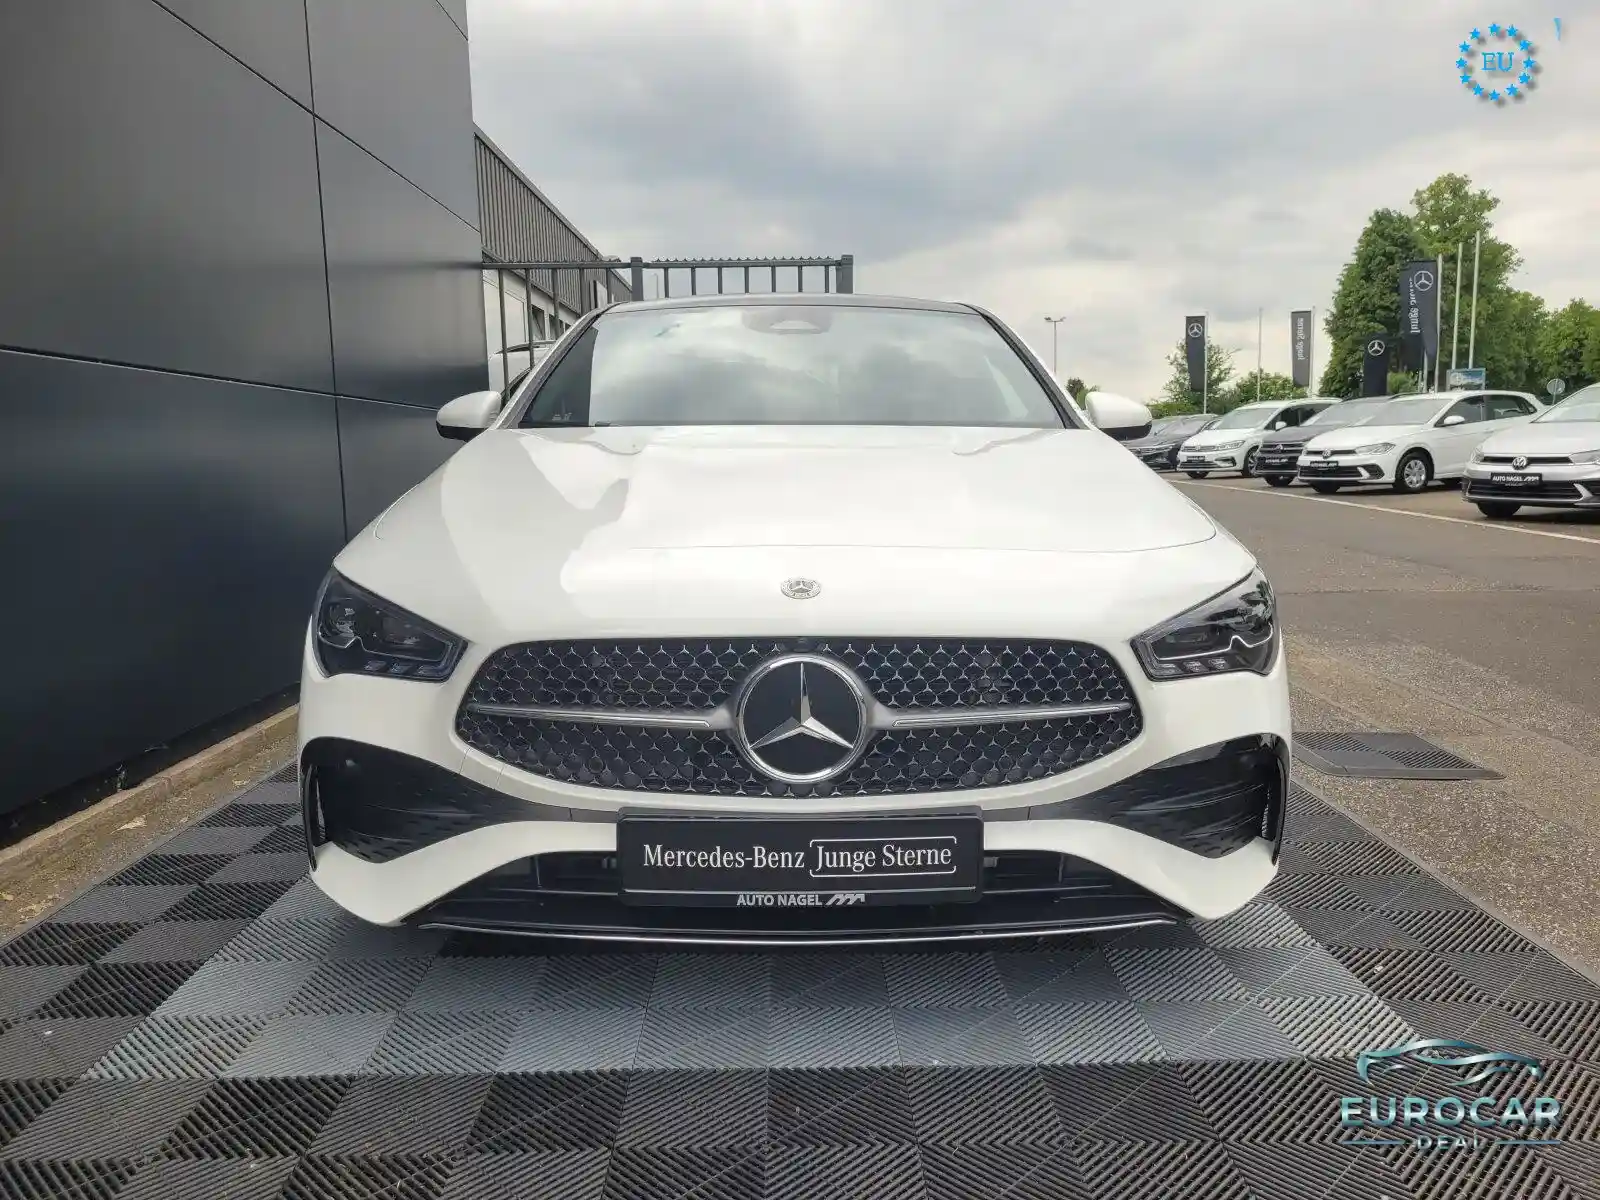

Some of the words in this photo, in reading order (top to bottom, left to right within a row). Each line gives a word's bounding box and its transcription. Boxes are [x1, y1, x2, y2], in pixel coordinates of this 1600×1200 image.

[642, 843, 806, 870] Mercedes-Benz
[815, 845, 877, 873] Junge
[881, 843, 953, 868] Sterne
[736, 893, 774, 906] AUTO
[777, 893, 823, 906] NAGEL
